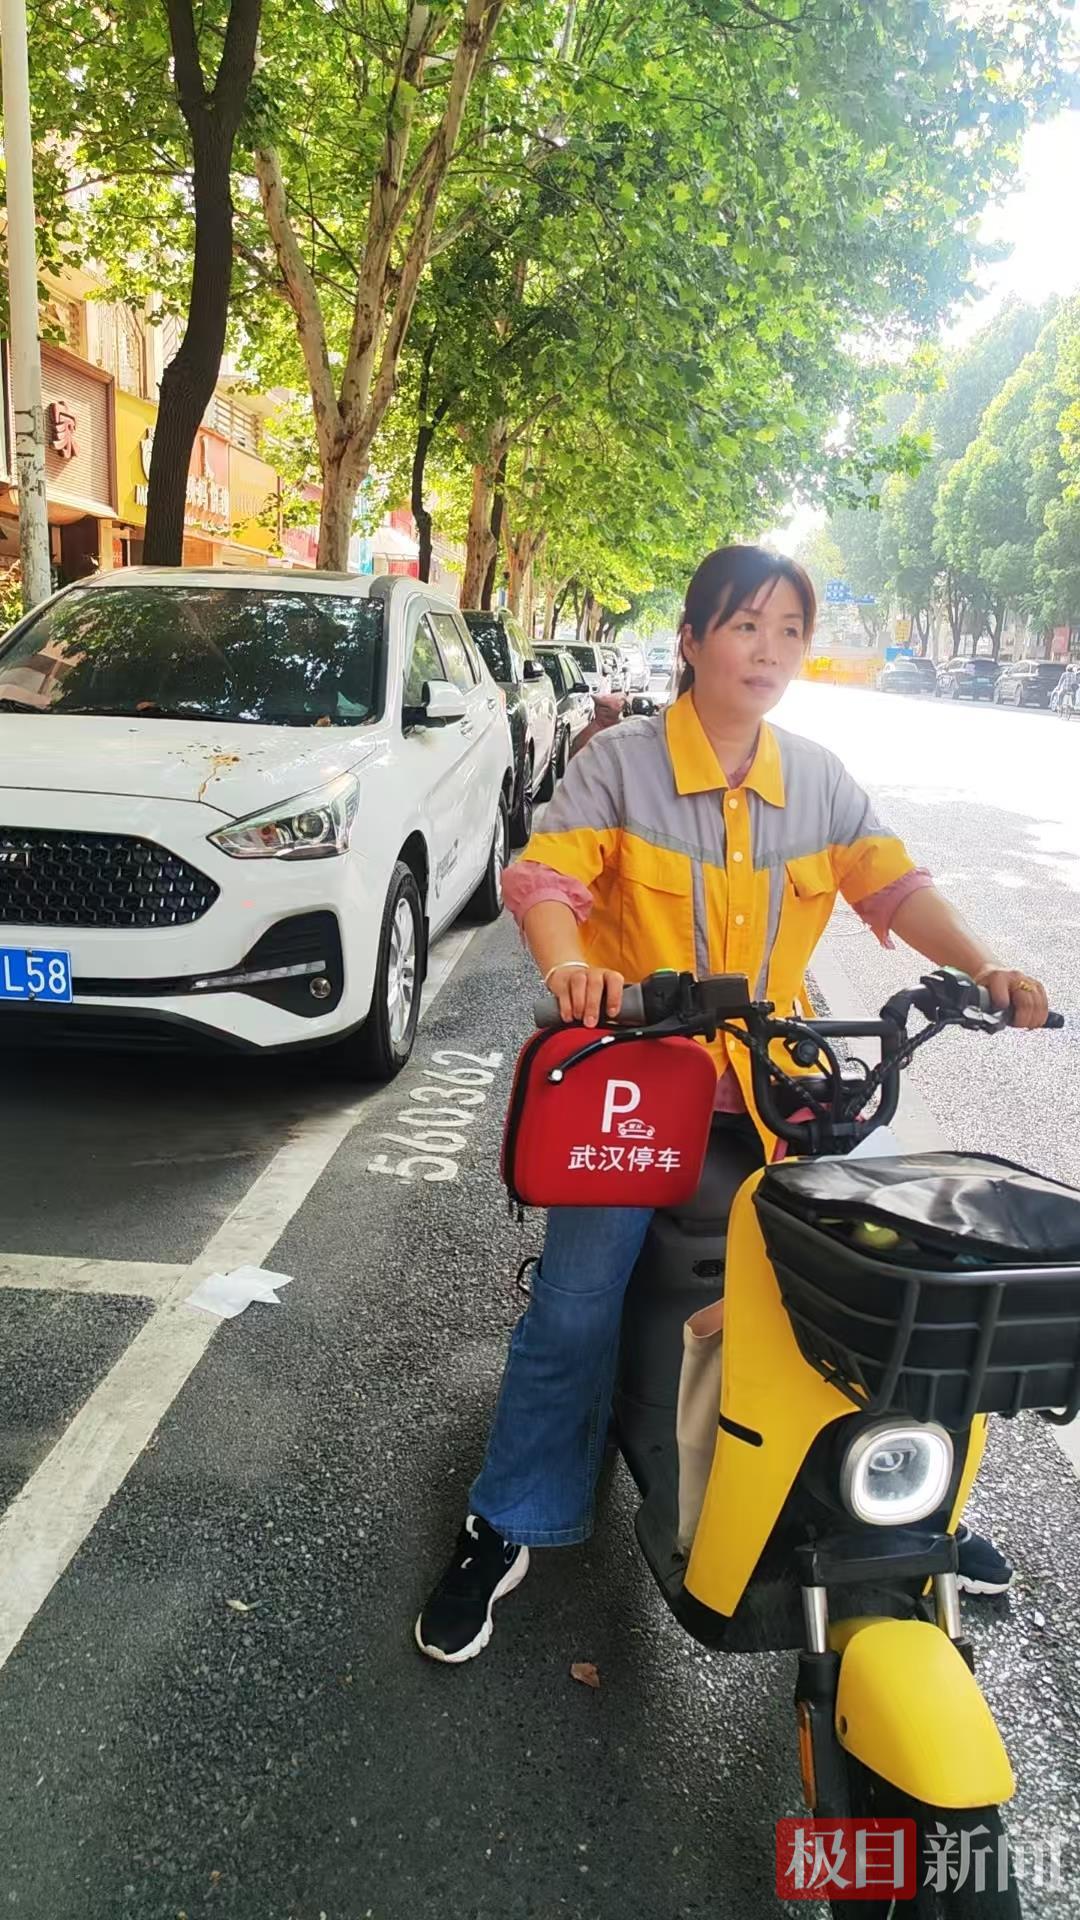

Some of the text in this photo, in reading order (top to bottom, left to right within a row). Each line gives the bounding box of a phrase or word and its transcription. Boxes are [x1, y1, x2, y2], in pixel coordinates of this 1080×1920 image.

[366, 1050, 504, 1185] 560362
[601, 1079, 641, 1133] P
[567, 1144, 682, 1173] 武汉停车
